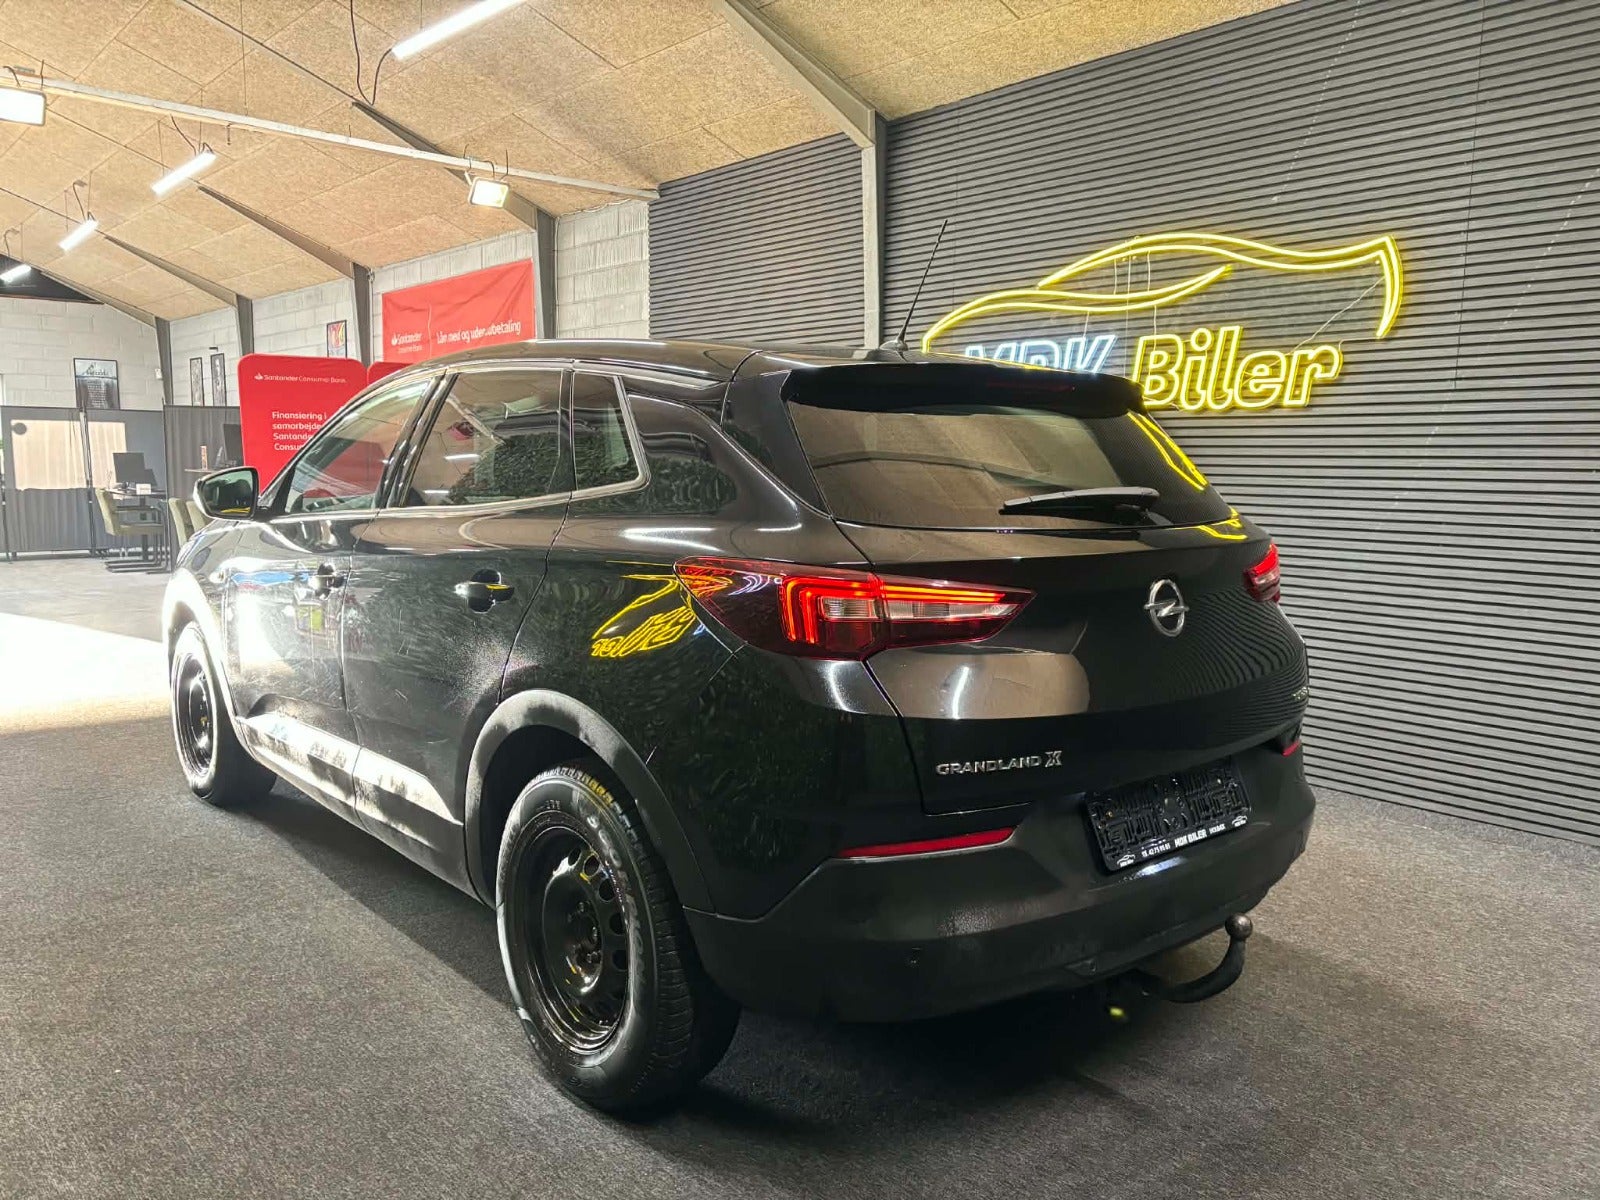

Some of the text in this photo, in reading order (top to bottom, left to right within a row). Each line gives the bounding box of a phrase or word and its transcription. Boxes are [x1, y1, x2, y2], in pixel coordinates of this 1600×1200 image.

[964, 325, 1343, 410] DK Biler
[263, 374, 298, 382] Santander
[272, 411, 323, 421] Finansiering
[273, 432, 314, 440] Santande
[936, 750, 1063, 775] GRANDLAND X
